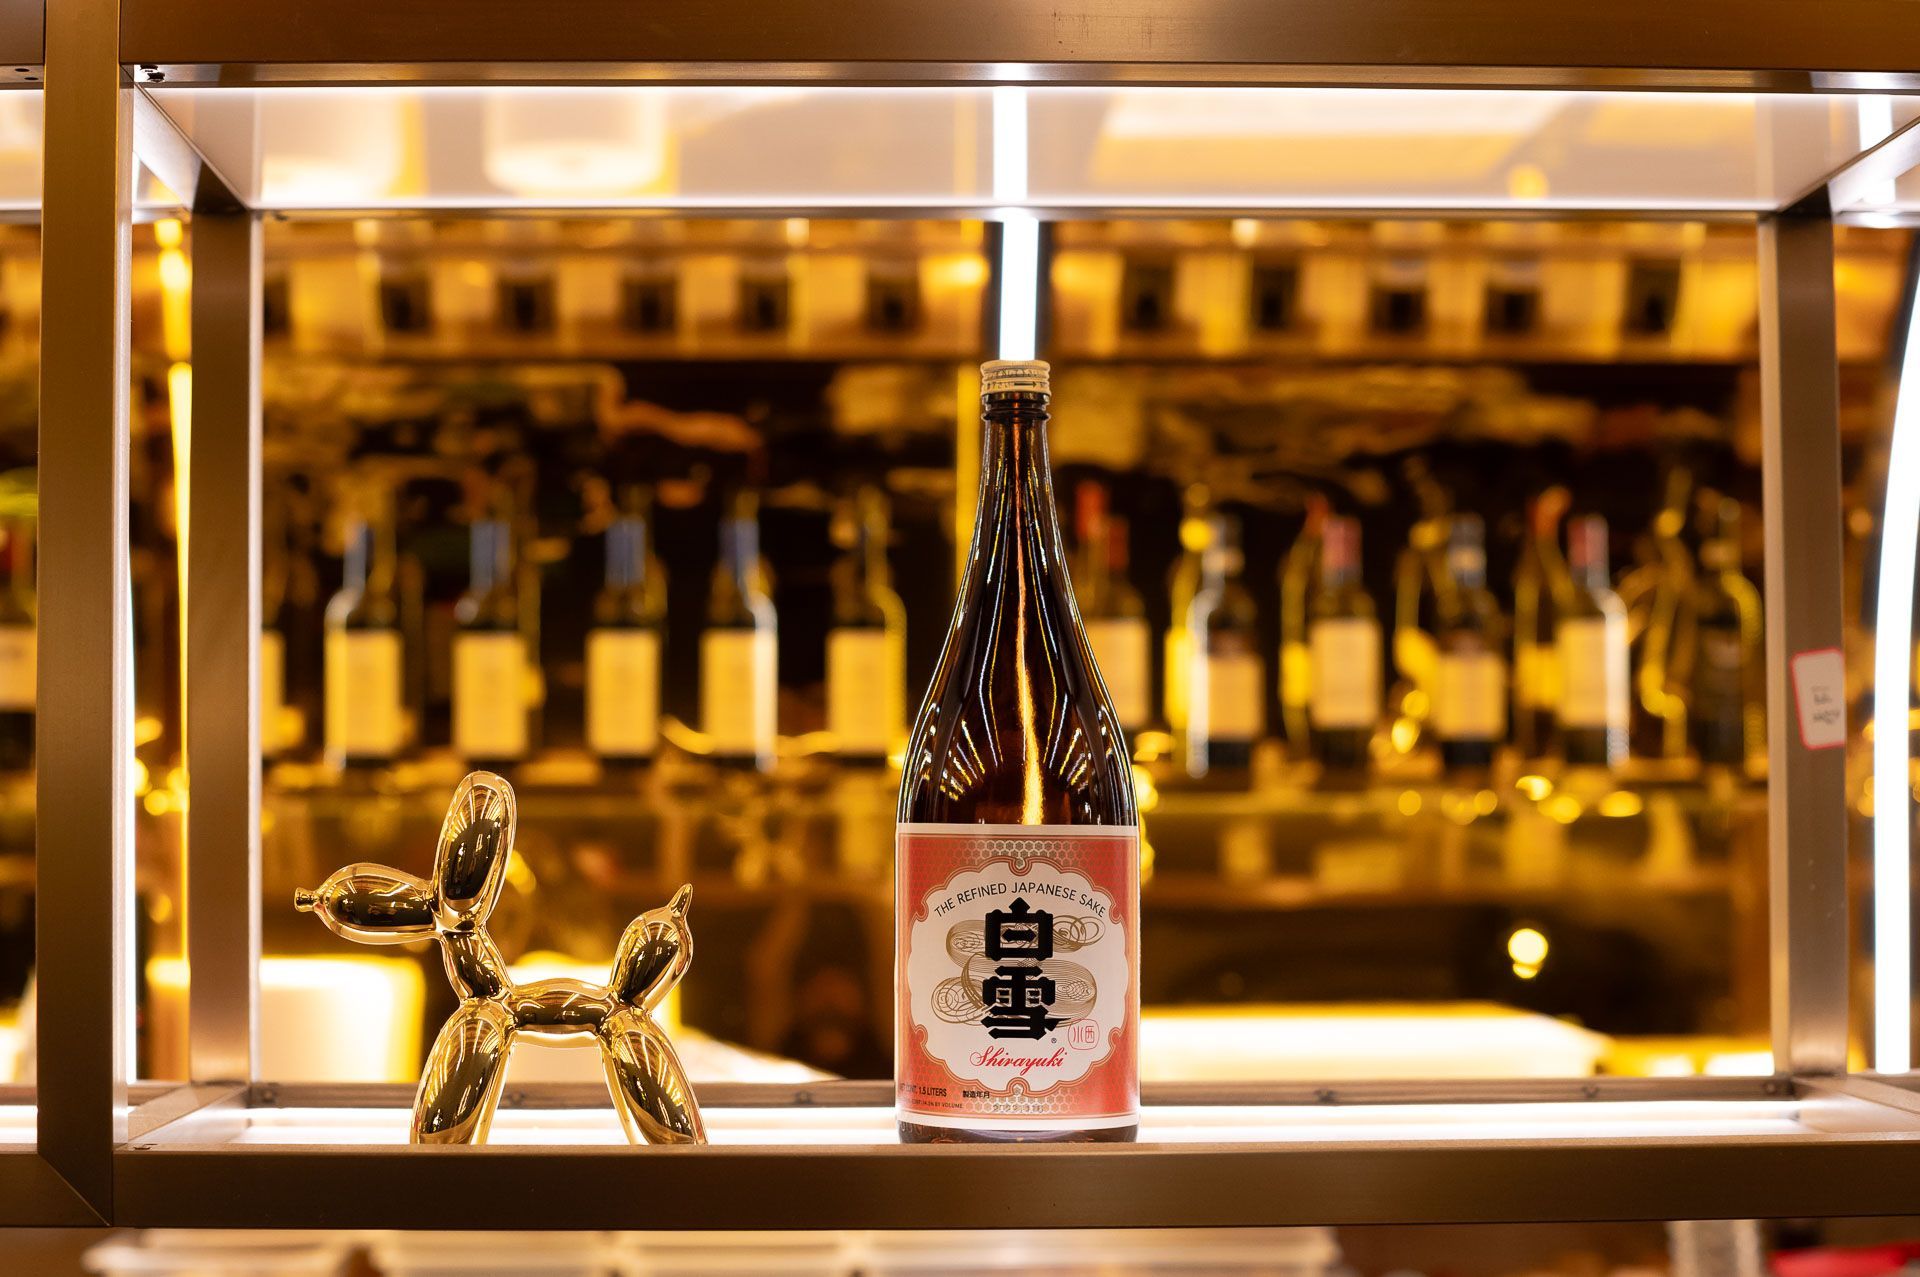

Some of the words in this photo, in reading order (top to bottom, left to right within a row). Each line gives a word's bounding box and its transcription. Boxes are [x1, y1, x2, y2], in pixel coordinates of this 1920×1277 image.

[934, 897, 955, 917] THE
[956, 882, 1007, 904] REFINED
[1011, 882, 1077, 901] JAPANESE
[1079, 893, 1106, 918] SAKE
[981, 896, 1072, 1041] 白雪
[969, 1045, 1068, 1076] Shirayuki
[918, 1086, 927, 1095] 1.5
[927, 1087, 947, 1097] LITERS
